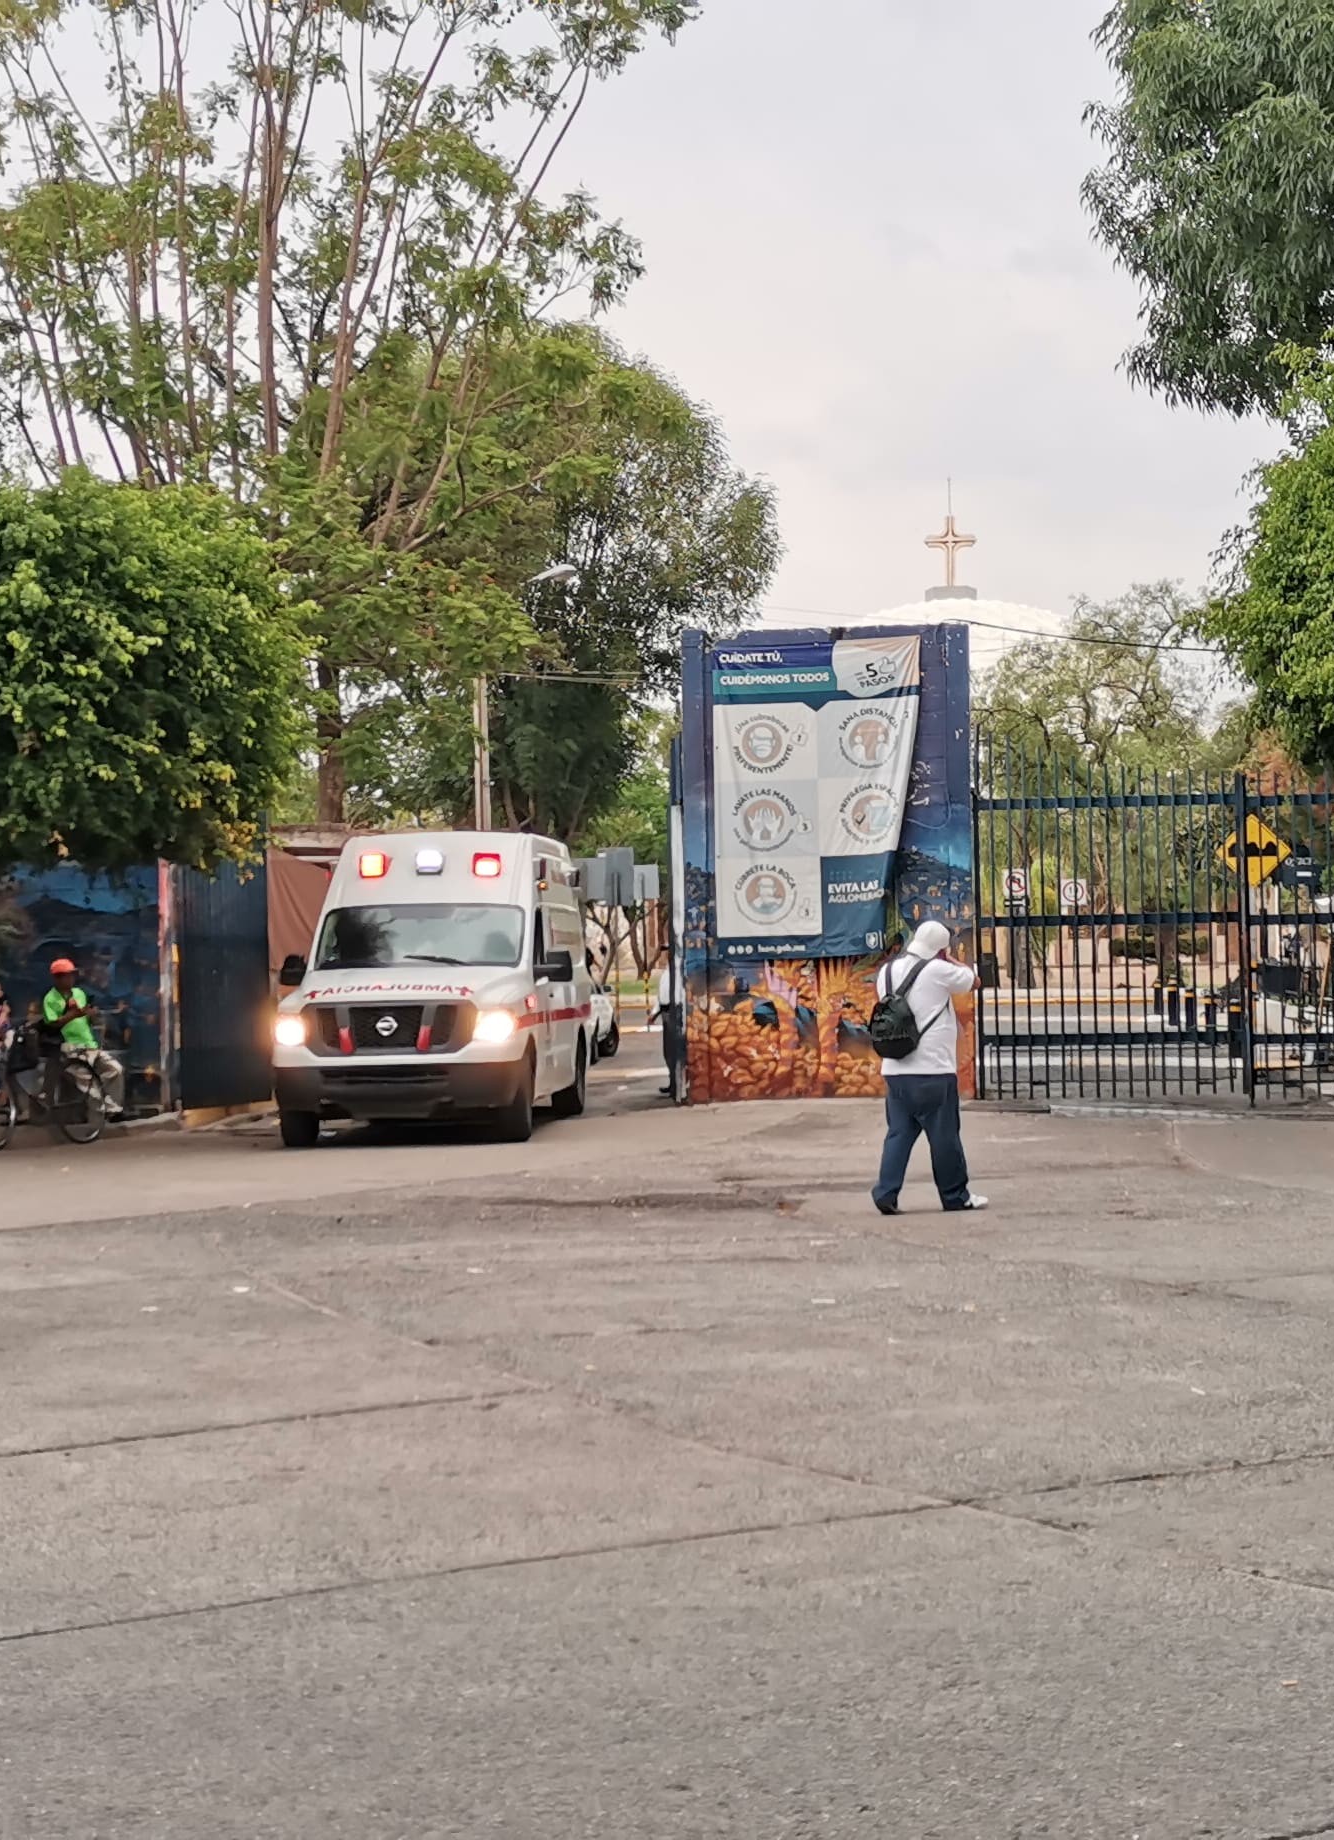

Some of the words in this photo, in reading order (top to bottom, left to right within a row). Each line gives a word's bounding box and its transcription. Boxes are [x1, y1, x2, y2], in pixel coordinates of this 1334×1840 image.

[866, 663, 878, 678] 5
[720, 672, 791, 686] CUIDÉMONOS
[793, 671, 830, 683] TODOS
[859, 674, 895, 688] PASOS
[838, 711, 859, 731] SANA
[755, 788, 772, 797] LAS
[772, 790, 797, 816] MANOS
[765, 864, 776, 872] LA
[777, 868, 796, 889] BOCA
[828, 882, 860, 894] EVITA
[861, 879, 879, 891] LAS
